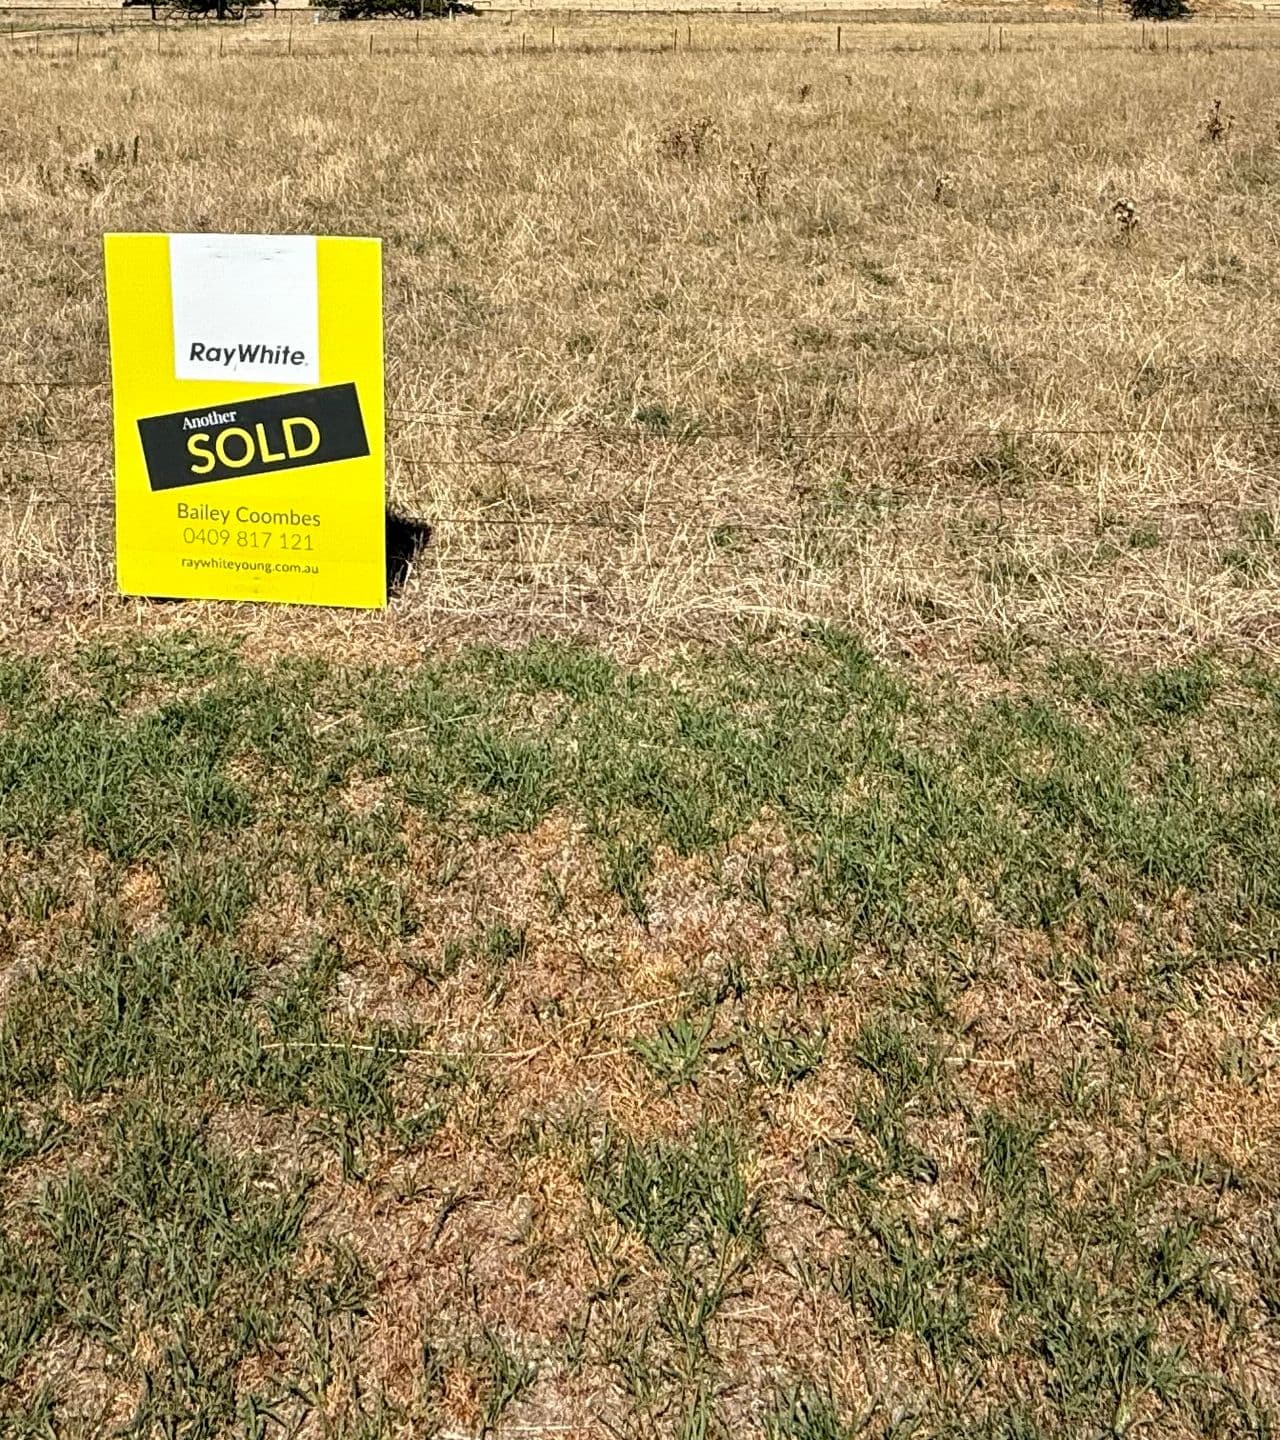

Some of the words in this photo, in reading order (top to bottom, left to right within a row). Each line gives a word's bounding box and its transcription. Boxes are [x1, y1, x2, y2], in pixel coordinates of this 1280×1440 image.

[182, 410, 237, 430] Another
[186, 416, 321, 474] SOLD
[177, 502, 230, 525] Bailey
[235, 506, 321, 527] Coombes
[183, 527, 230, 546] 0409
[236, 530, 272, 549] 817
[280, 533, 314, 551] 121
[181, 557, 320, 575] raywhiteyoung.com.au
